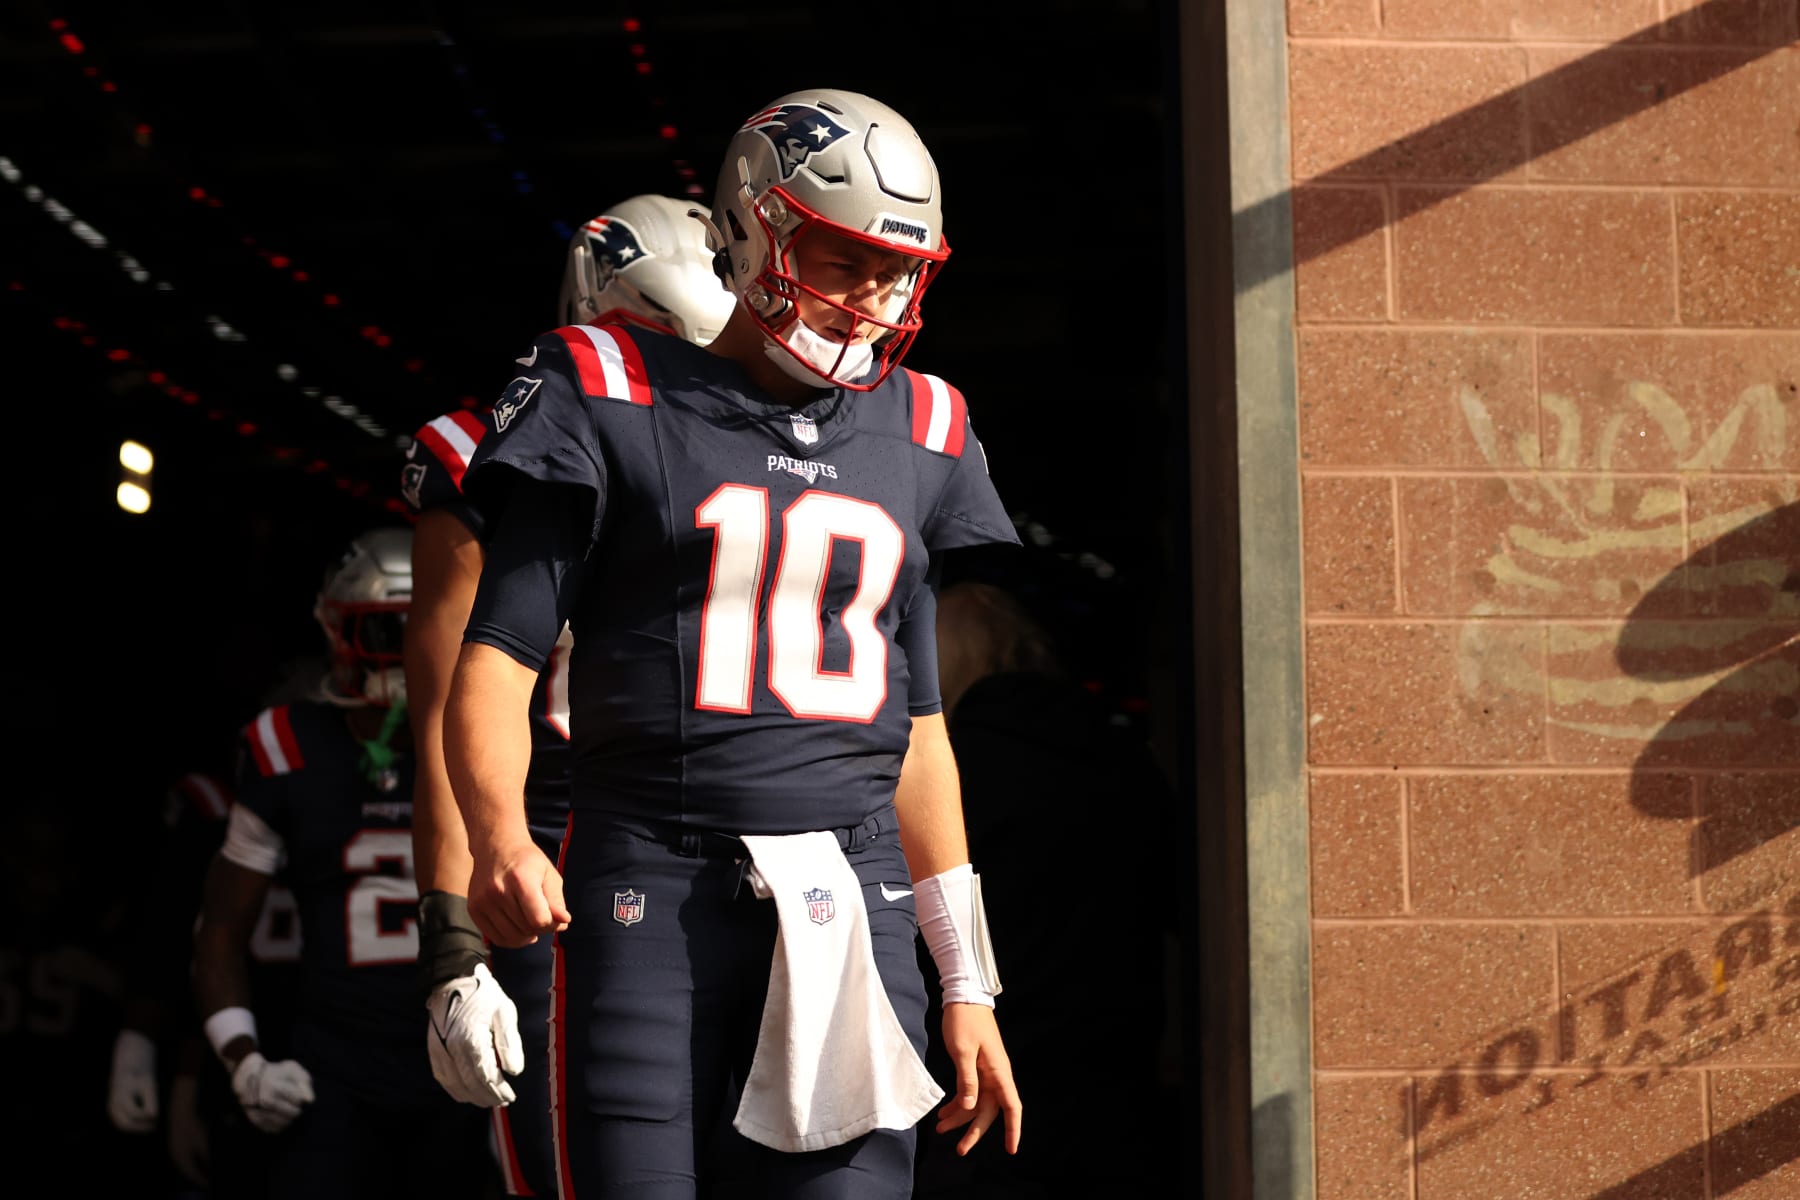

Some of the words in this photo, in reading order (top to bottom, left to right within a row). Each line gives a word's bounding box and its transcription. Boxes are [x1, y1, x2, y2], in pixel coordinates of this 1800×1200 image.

[880, 218, 928, 244] PATRIOTS
[767, 455, 838, 480] PATRIOTS
[694, 482, 905, 724] 10
[618, 905, 638, 919] NFL
[810, 902, 833, 920] NFL
